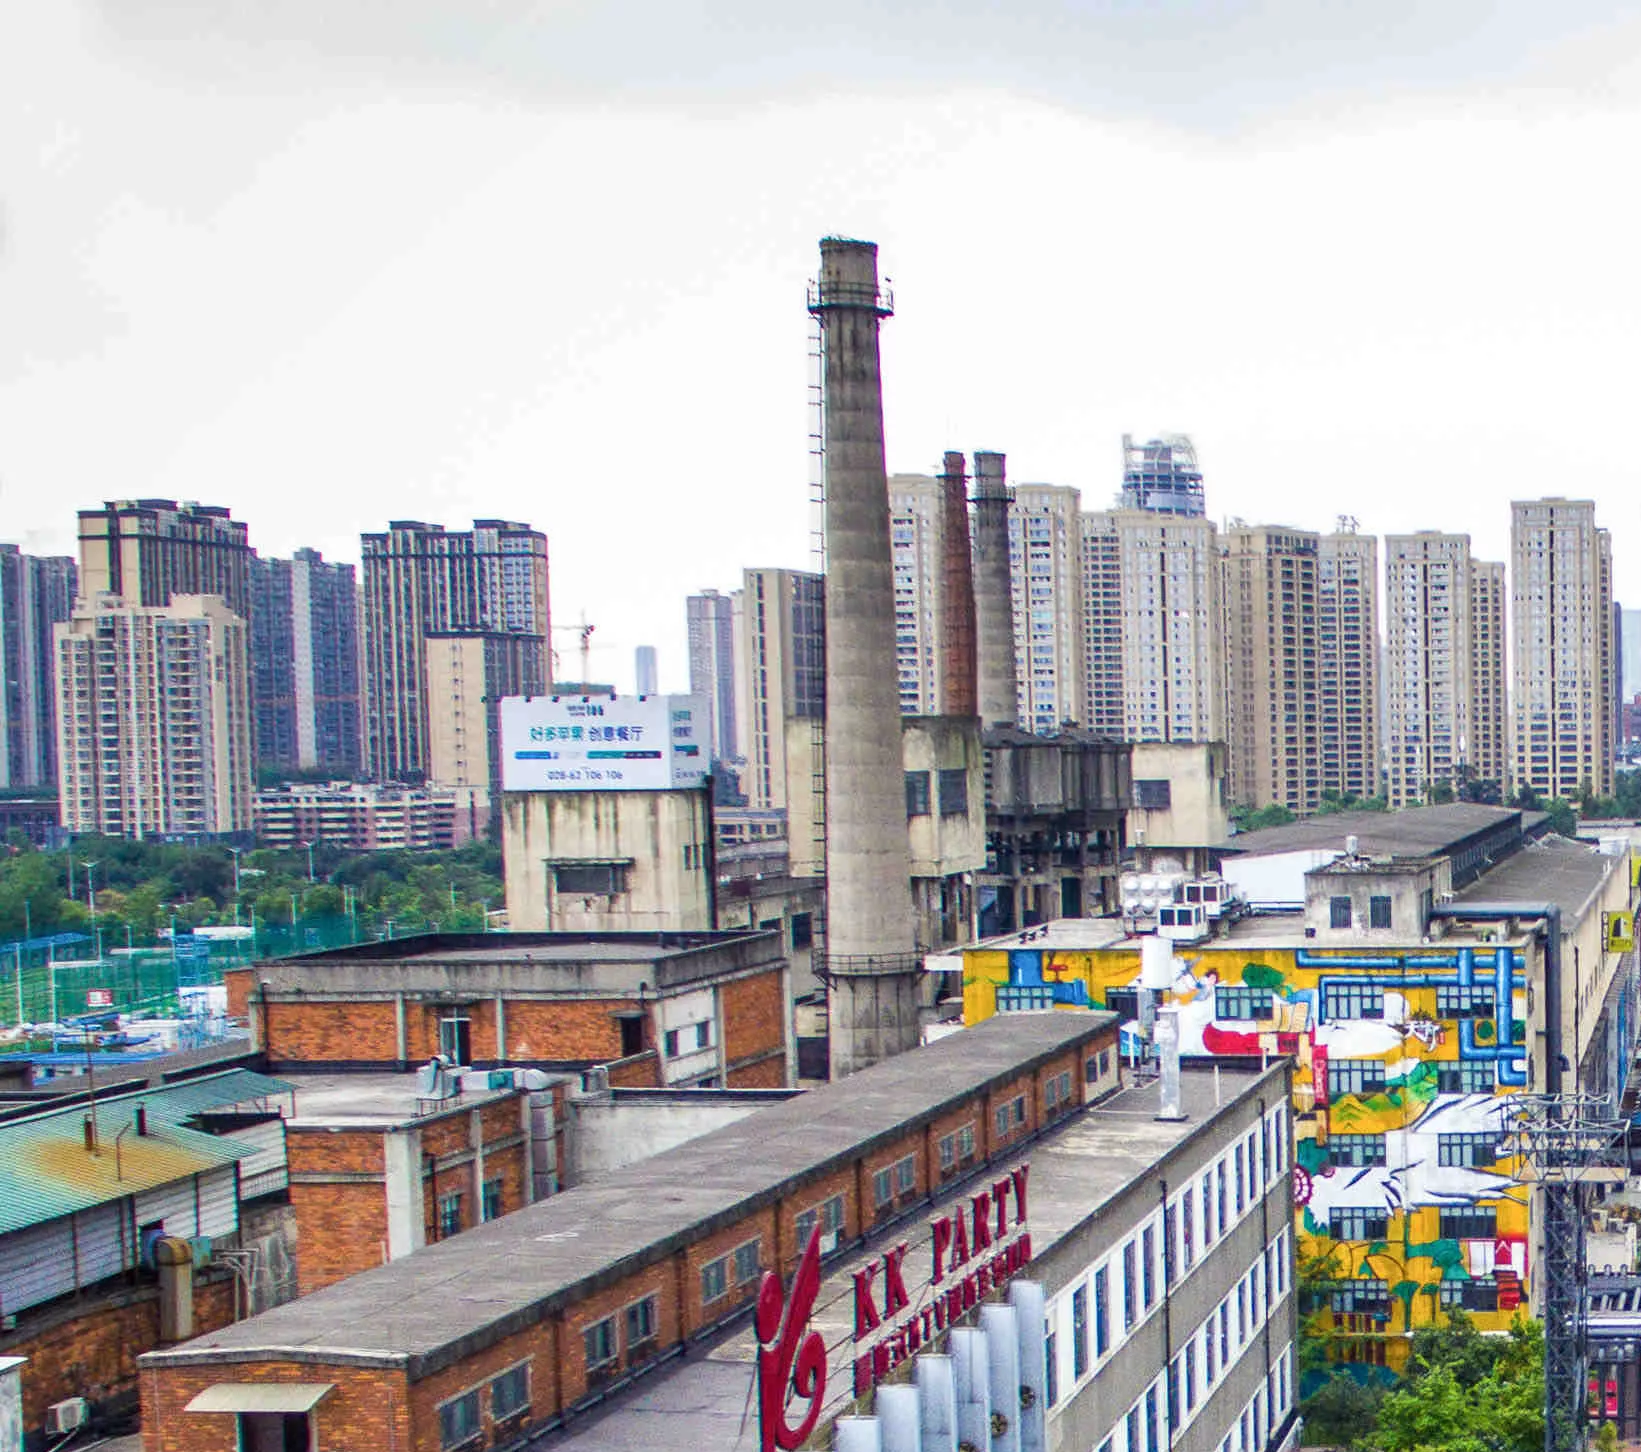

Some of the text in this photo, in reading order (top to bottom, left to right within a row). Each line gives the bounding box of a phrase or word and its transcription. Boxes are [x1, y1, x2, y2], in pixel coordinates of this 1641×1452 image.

[588, 725, 644, 742] 创意餐厅
[851, 1238, 911, 1344] KK
[930, 1161, 1032, 1287] PARTY
